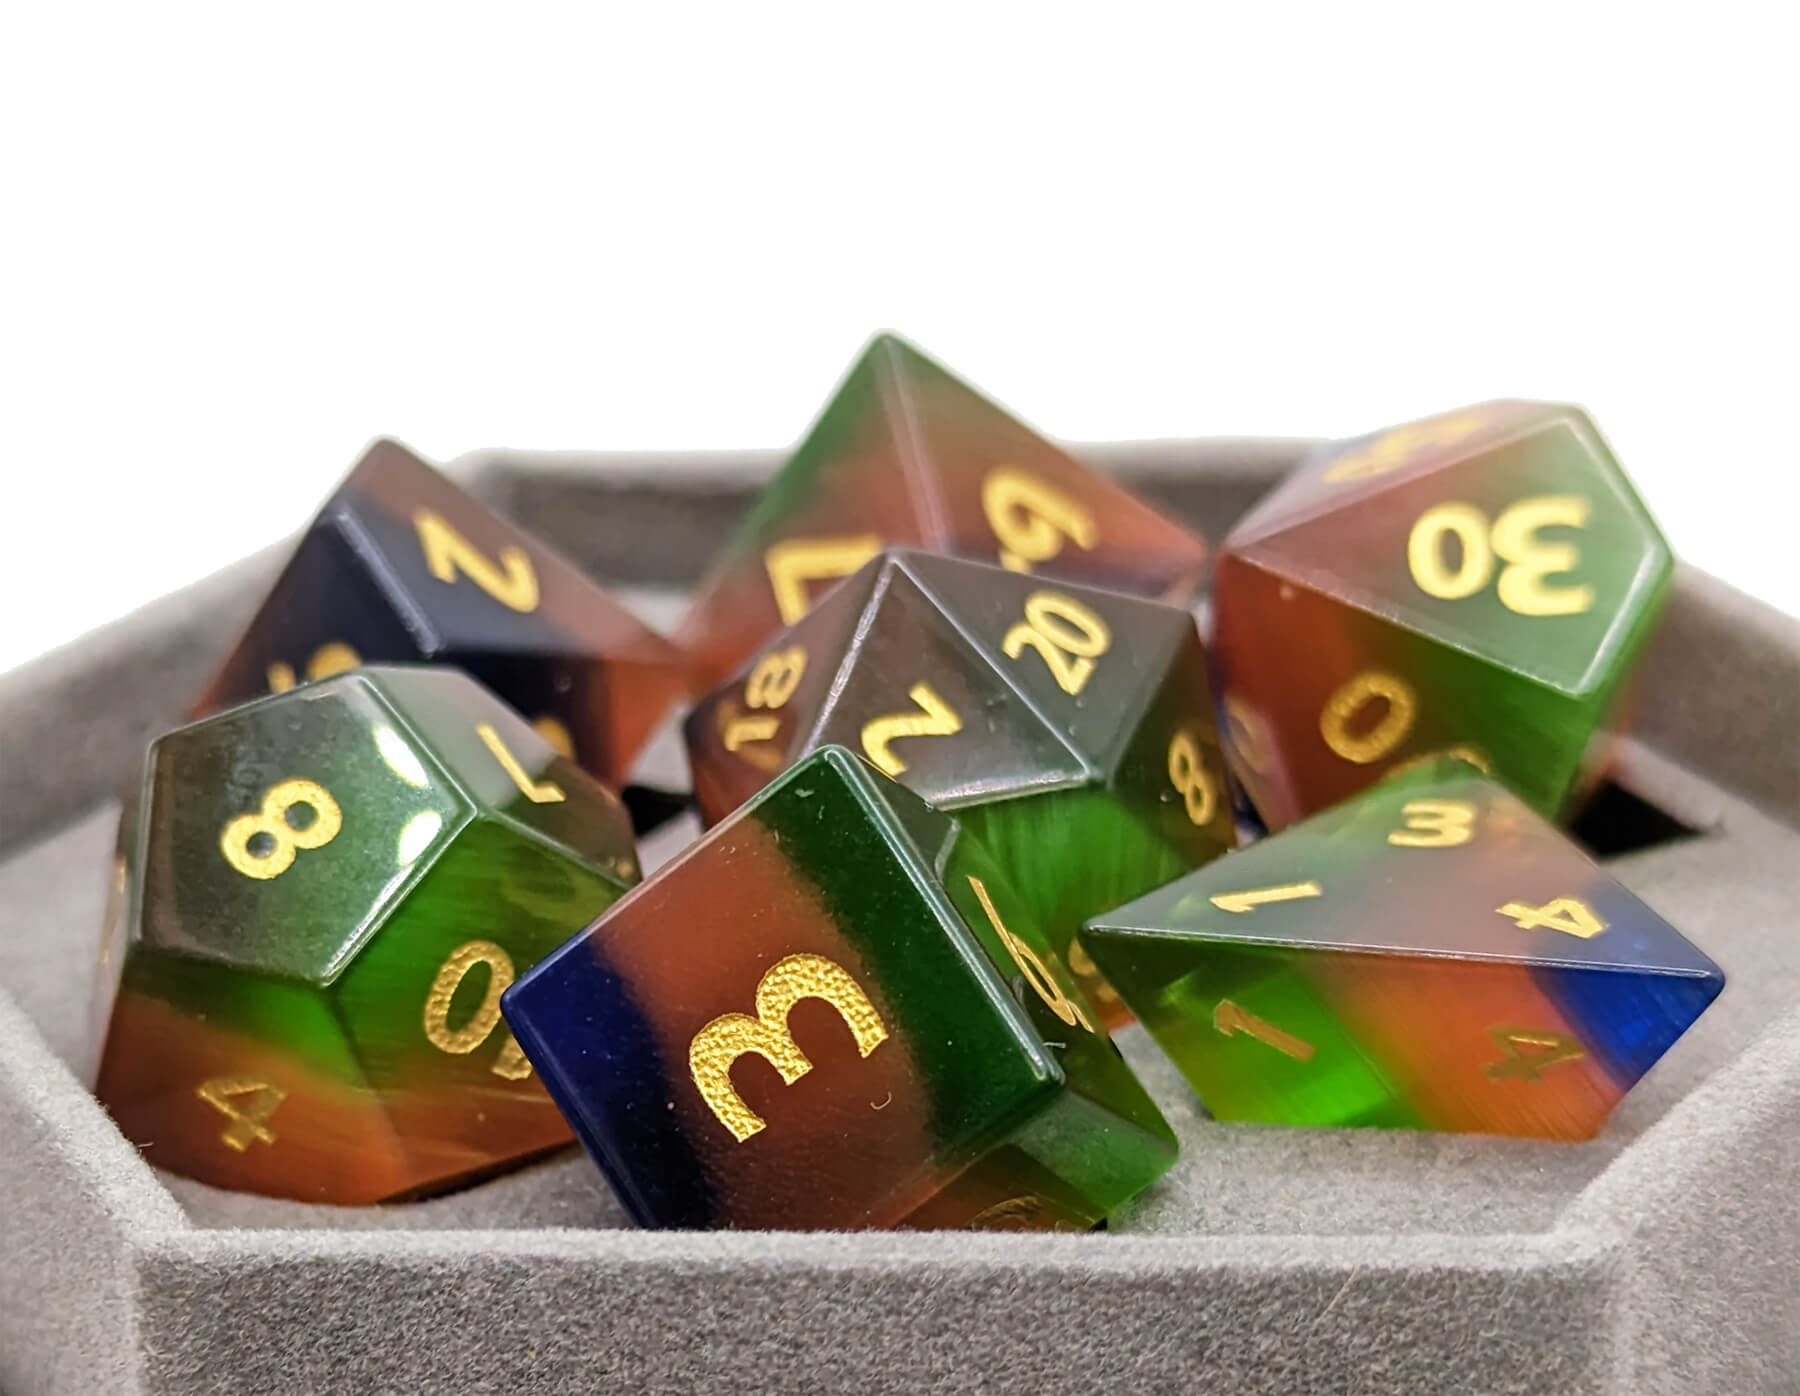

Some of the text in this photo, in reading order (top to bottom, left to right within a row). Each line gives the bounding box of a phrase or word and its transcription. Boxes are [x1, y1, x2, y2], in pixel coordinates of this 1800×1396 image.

[414, 507, 540, 613] 2
[764, 532, 885, 627] 7
[1405, 494, 1594, 617] 30
[1002, 590, 1112, 697] 20
[722, 645, 808, 753] 18
[860, 682, 963, 777] 2
[1167, 731, 1216, 826] 8
[1387, 800, 1476, 849] 3
[219, 777, 343, 880] 8
[1210, 880, 1322, 913] 1
[1495, 896, 1609, 939] 4
[689, 952, 889, 1142] 3
[1212, 998, 1318, 1063] 1
[1482, 1024, 1586, 1084] 4
[196, 1074, 289, 1153] 4
